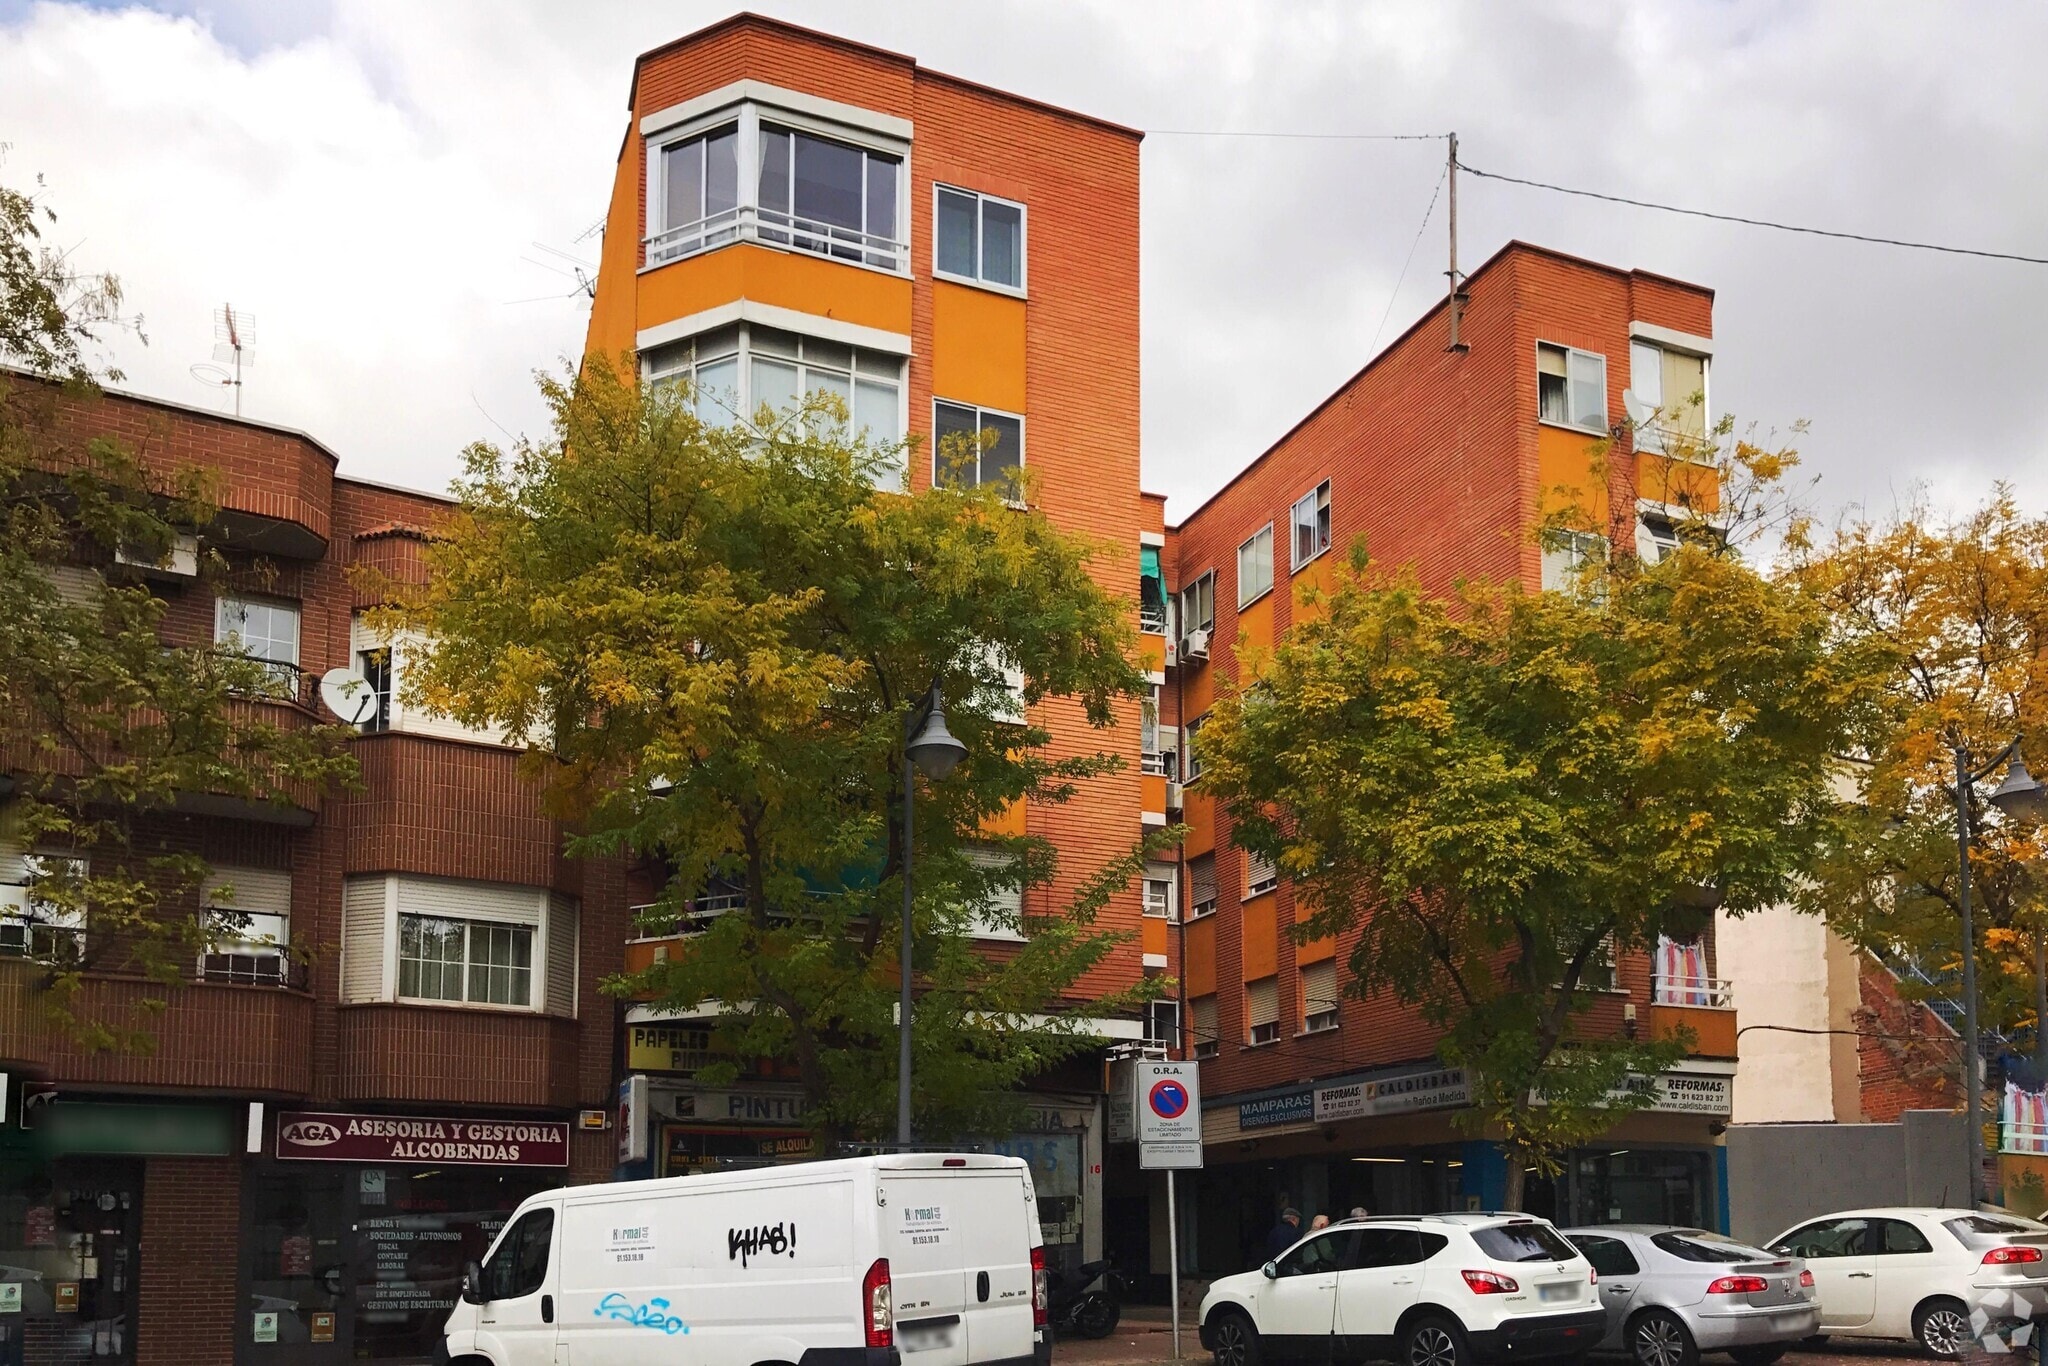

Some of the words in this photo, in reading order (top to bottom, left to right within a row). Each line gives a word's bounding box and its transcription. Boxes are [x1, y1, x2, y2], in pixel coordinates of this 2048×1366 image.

[635, 1029, 709, 1049] PAPELES
[1153, 1067, 1183, 1075] O.R.A.
[1379, 1072, 1461, 1094] CALDISBAN
[1668, 1079, 1725, 1092] REFORMAS:
[1321, 1087, 1361, 1101] REFORMAS:
[1438, 1091, 1465, 1103] Medida
[1241, 1094, 1311, 1116] MAMPARAS
[1660, 1101, 1729, 1112] www.caldisban.com
[1242, 1112, 1269, 1127] DISEÑOS
[1270, 1108, 1312, 1122] EXCLUSIVOS
[286, 1125, 337, 1142] AGA
[345, 1119, 446, 1139] ASESORIA
[451, 1124, 463, 1140] Y
[467, 1125, 562, 1143] GESTORIA
[391, 1141, 520, 1161] ALCOBENDAS
[761, 1142, 773, 1155] SE
[775, 1137, 815, 1153] ALQUILA
[1090, 1165, 1100, 1174] 16
[370, 1219, 393, 1228] RENTA
[370, 1231, 414, 1241] SOCIEDADES
[419, 1232, 462, 1241] AUTONOMOS
[377, 1252, 409, 1260] CONTABLE
[377, 1262, 405, 1270] LABORAL
[367, 1301, 399, 1310] GESTION
[400, 1300, 409, 1309] DE
[410, 1300, 454, 1309] ESCRITURAS
